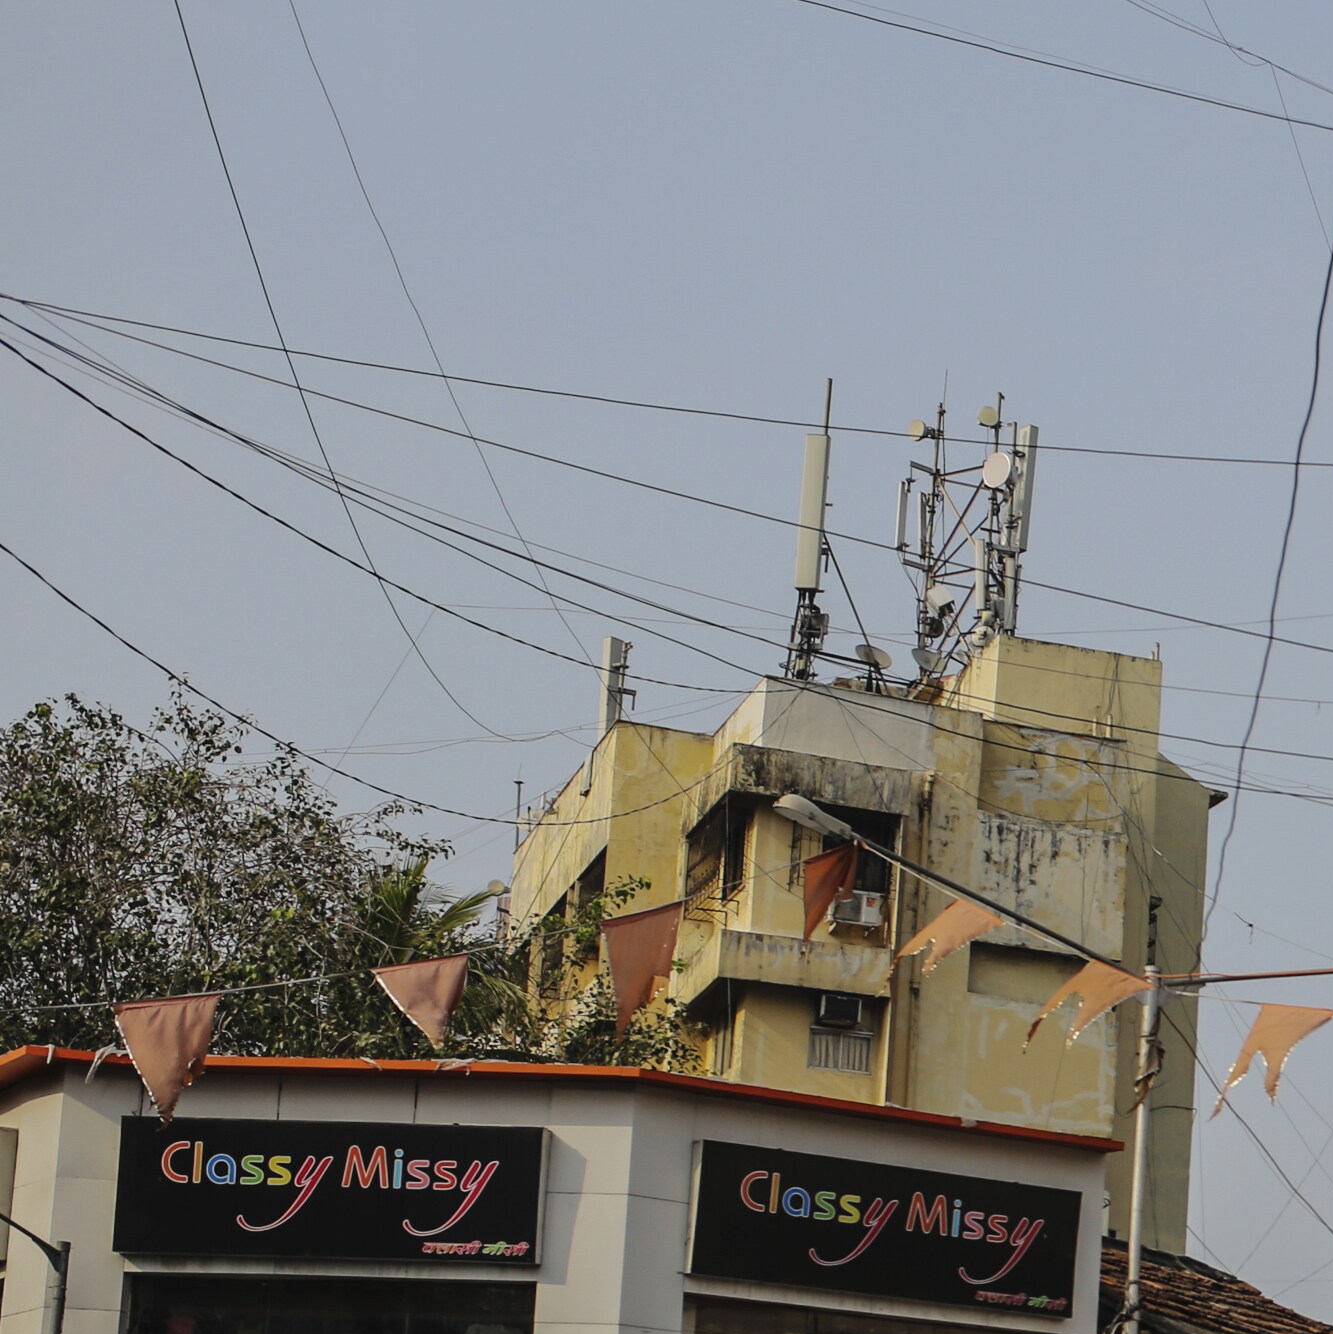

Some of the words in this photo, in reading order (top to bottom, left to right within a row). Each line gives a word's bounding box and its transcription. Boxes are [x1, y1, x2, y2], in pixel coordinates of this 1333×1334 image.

[161, 1139, 333, 1232] Classy
[341, 1144, 500, 1237] Missy
[740, 1170, 898, 1267] Classy
[906, 1191, 1044, 1285] Missy
